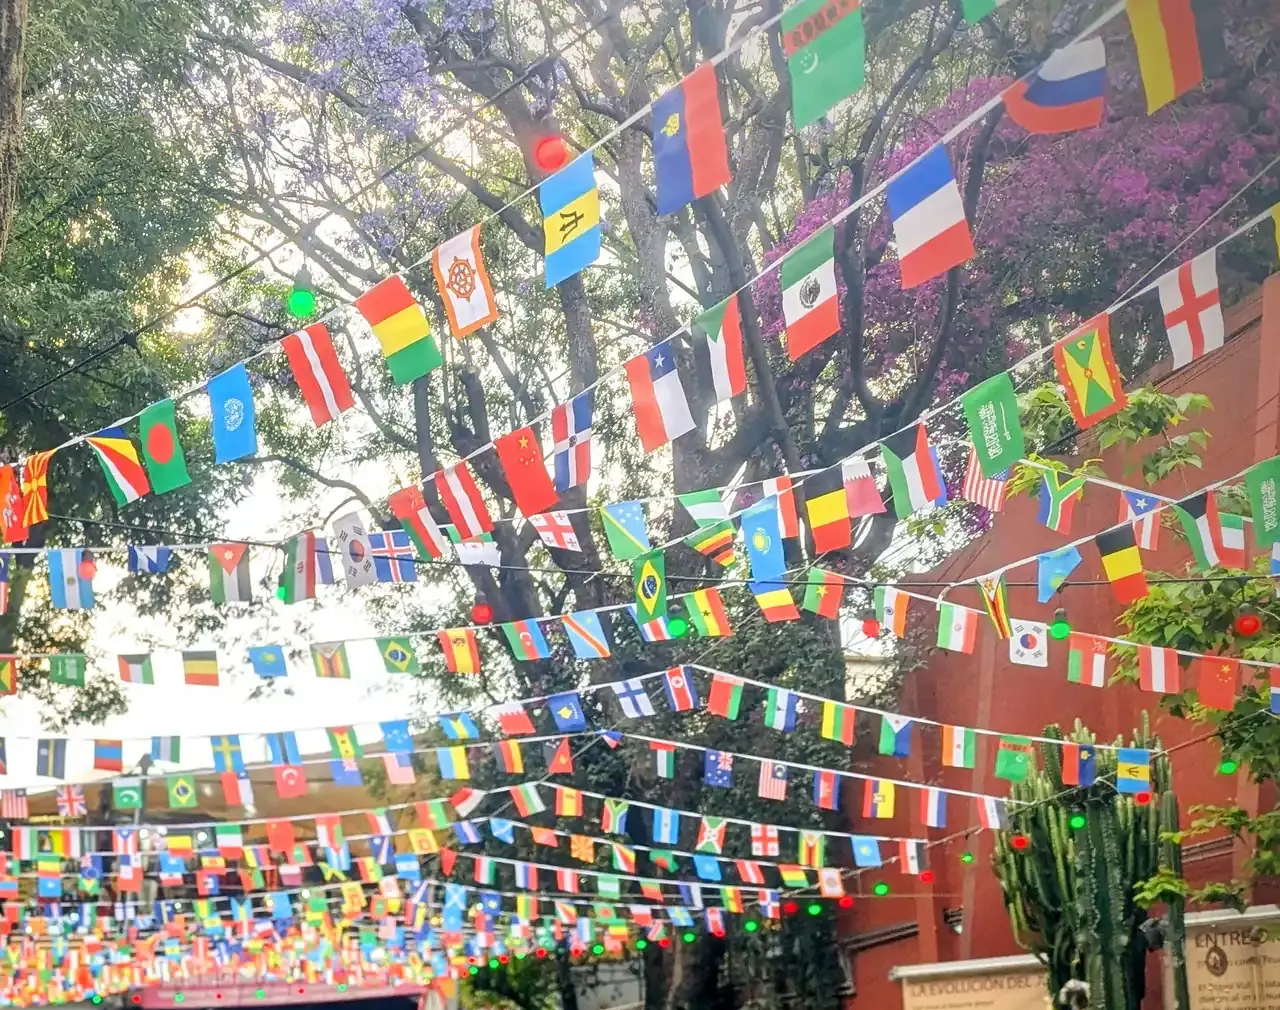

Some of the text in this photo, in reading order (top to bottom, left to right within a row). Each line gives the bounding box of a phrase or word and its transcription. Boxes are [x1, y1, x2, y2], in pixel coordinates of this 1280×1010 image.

[1195, 930, 1252, 948] ENTRE
[911, 983, 928, 998] LA
[930, 977, 1004, 996] EVOLUCIÓN
[1007, 975, 1031, 989] DEL
